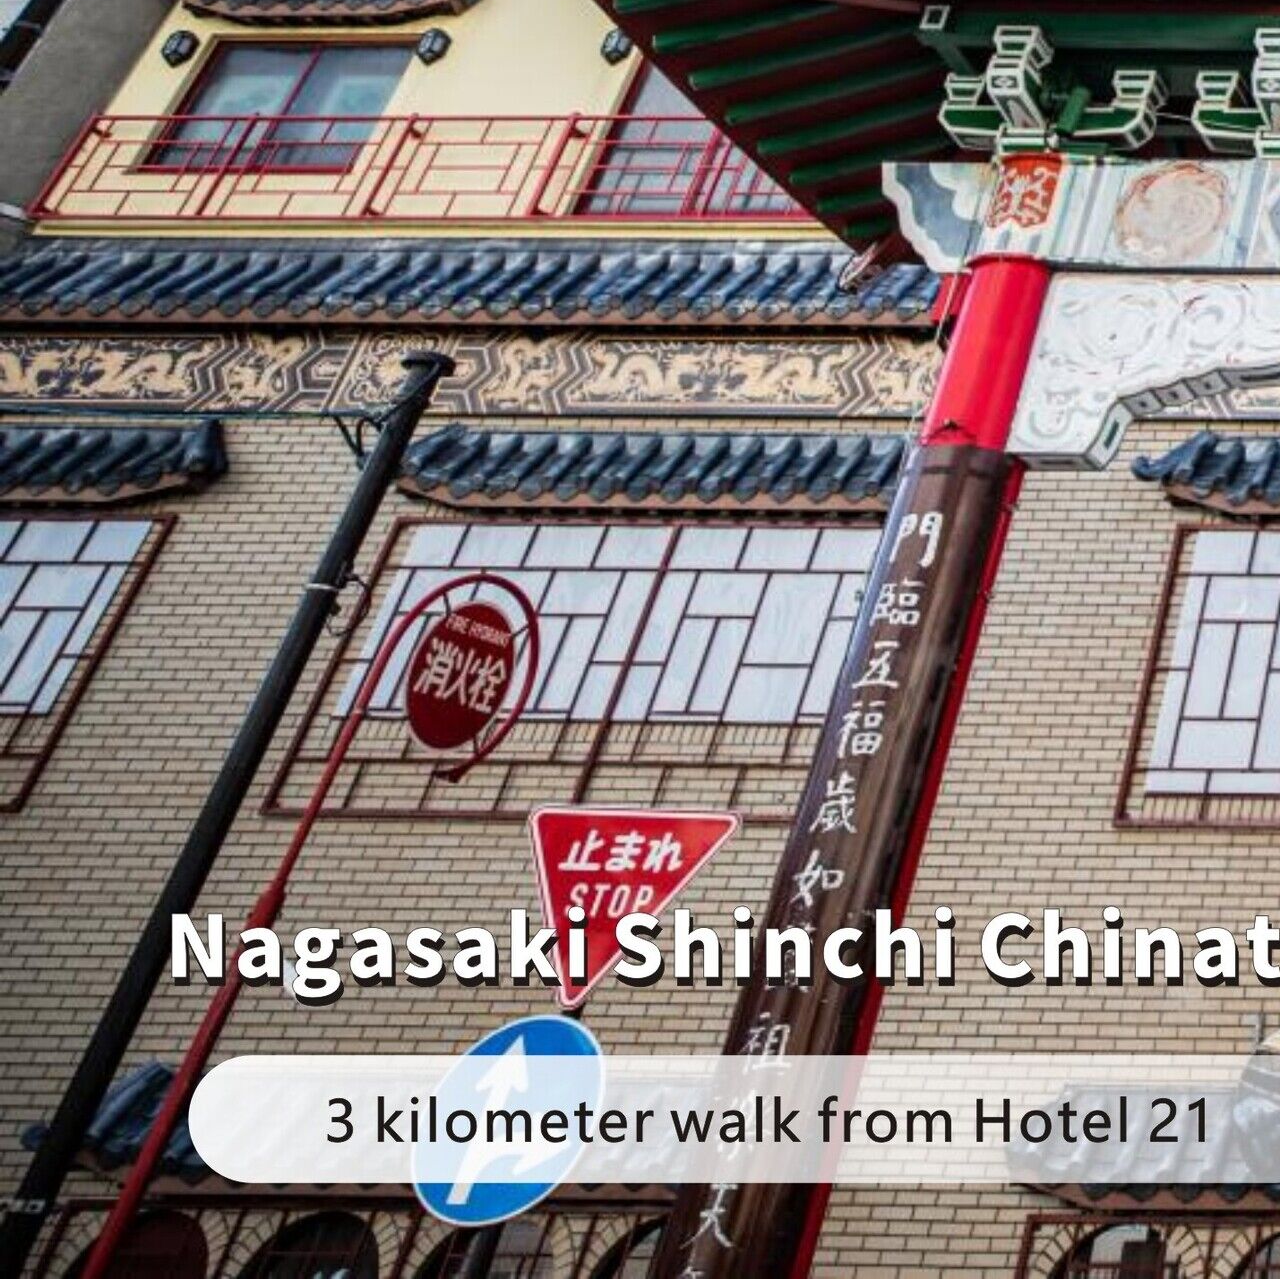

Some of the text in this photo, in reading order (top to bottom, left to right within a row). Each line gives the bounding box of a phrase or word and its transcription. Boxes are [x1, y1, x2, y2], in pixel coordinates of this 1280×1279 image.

[413, 637, 507, 714] 消火栓
[558, 830, 684, 873] 止まれ
[565, 882, 654, 918] STOP
